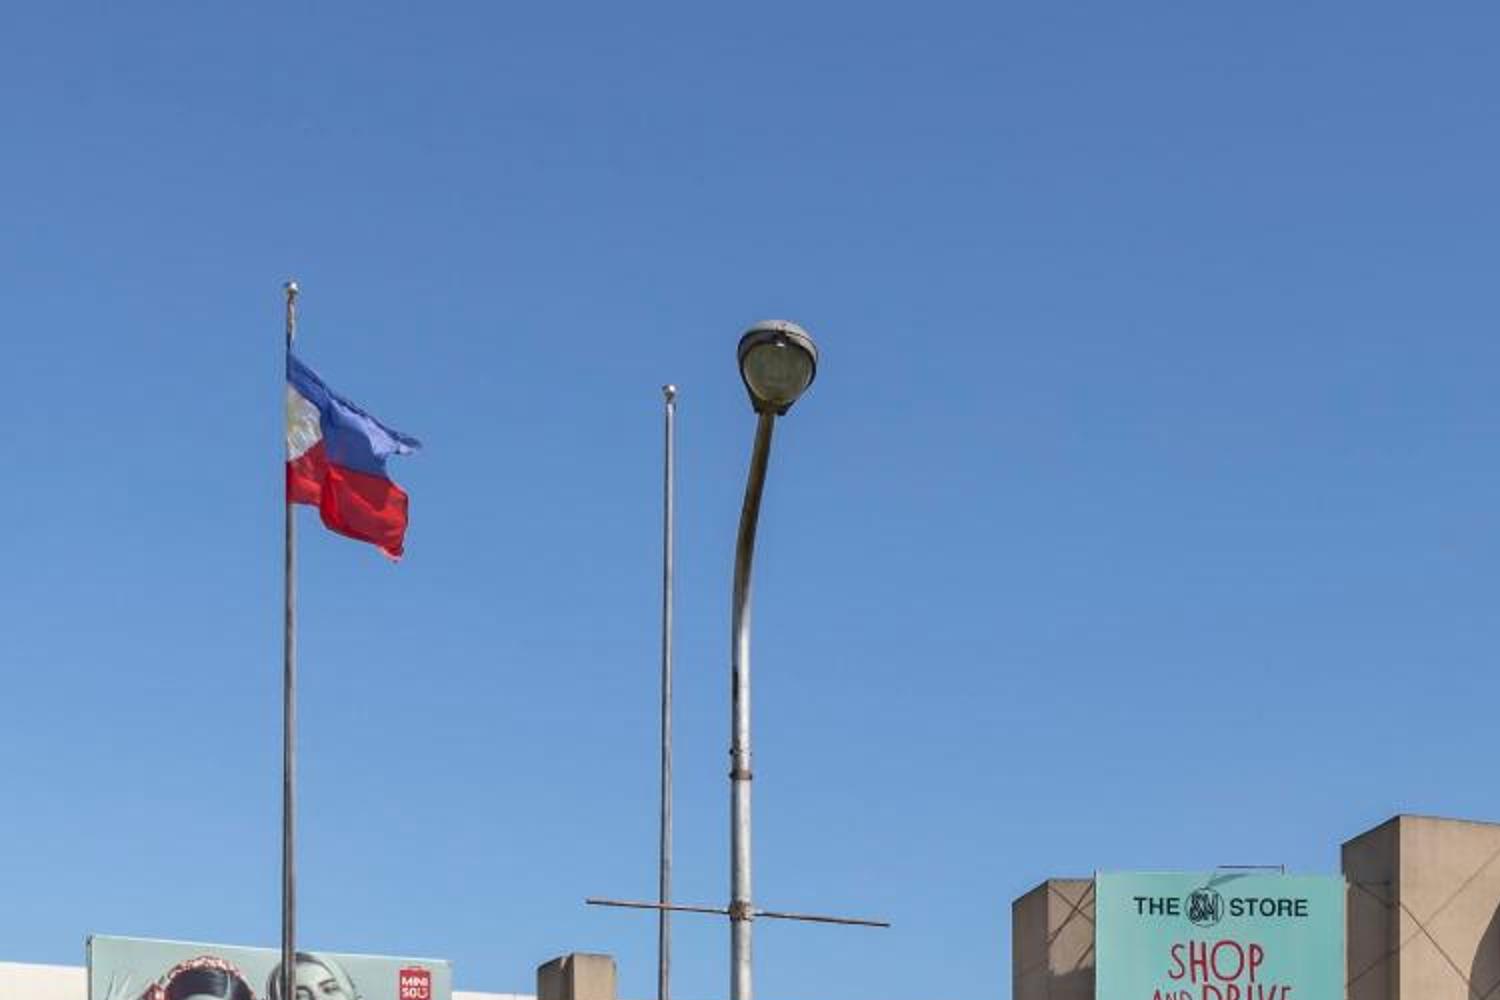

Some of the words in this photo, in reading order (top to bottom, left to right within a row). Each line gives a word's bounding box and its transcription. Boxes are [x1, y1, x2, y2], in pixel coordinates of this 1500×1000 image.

[1133, 896, 1180, 915] THE
[1230, 898, 1308, 917] STORE
[1168, 939, 1264, 983] SHOP
[401, 976, 429, 987] MINI
